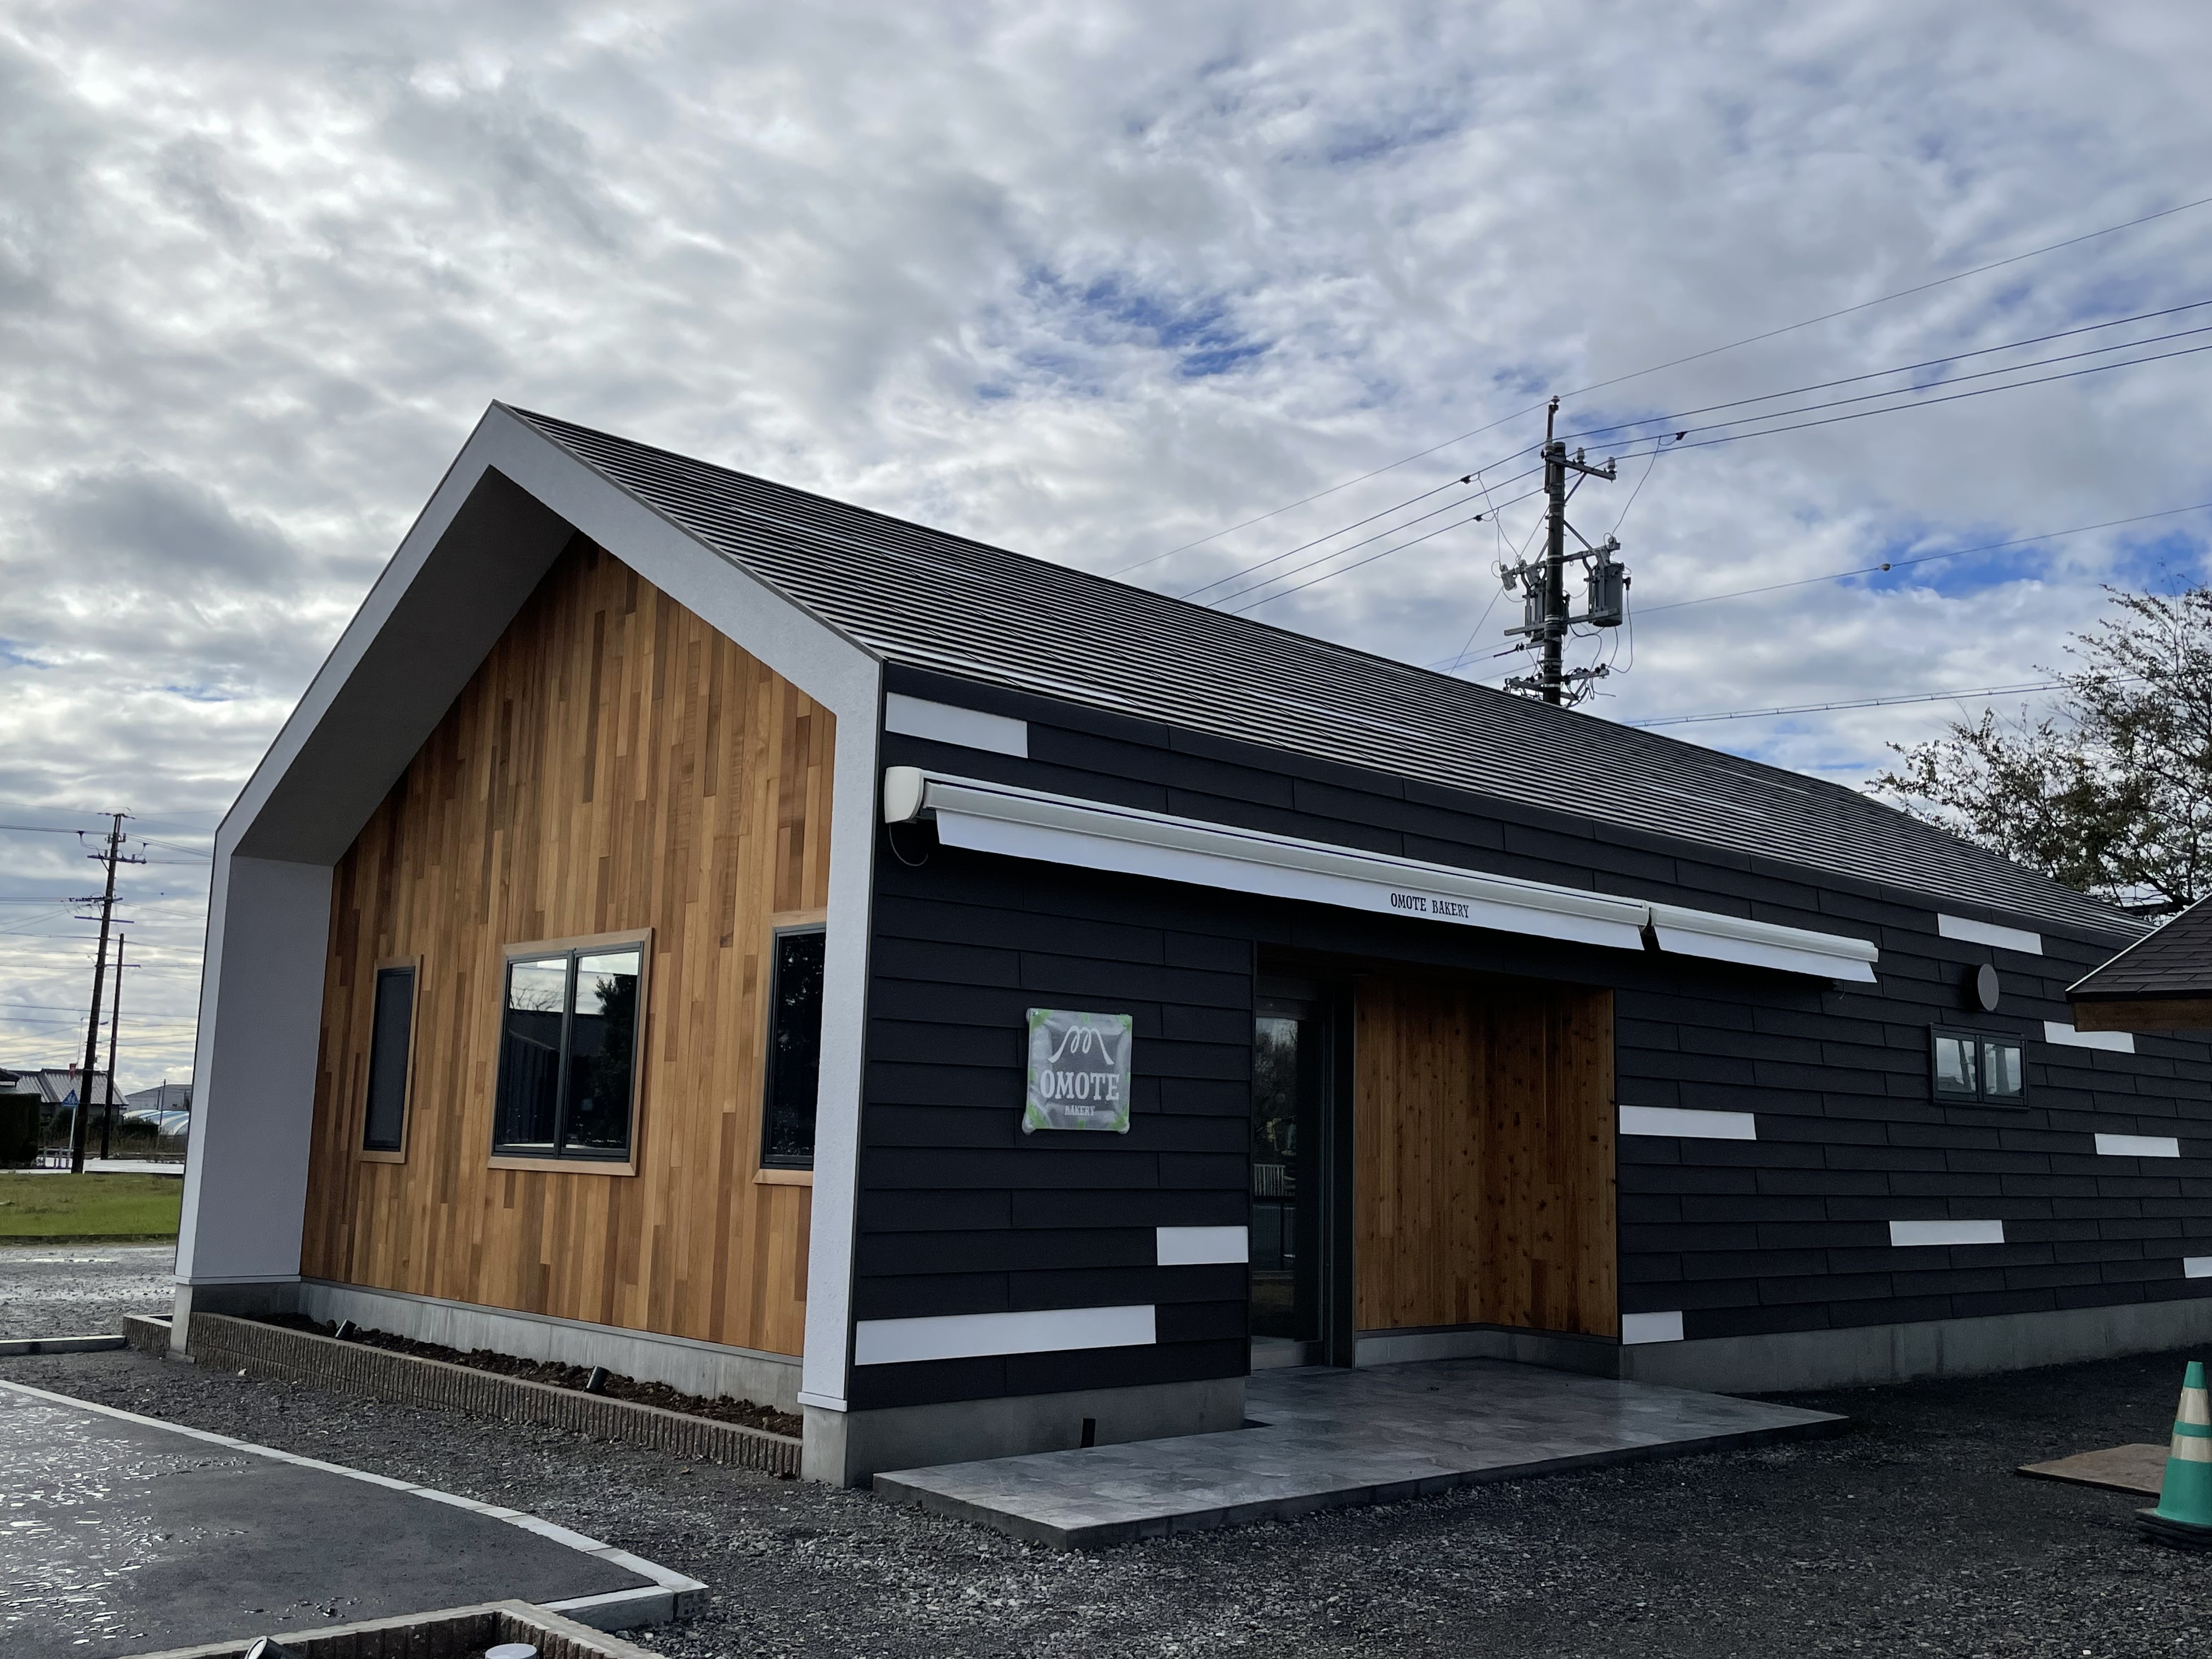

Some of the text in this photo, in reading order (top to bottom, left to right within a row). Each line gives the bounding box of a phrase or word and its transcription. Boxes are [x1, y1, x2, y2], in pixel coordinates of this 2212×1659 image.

[1391, 893, 1469, 918] OMOTE BAKERY
[1040, 1070, 1120, 1100] OMOTE
[1064, 1105, 1095, 1116] BAKERY
